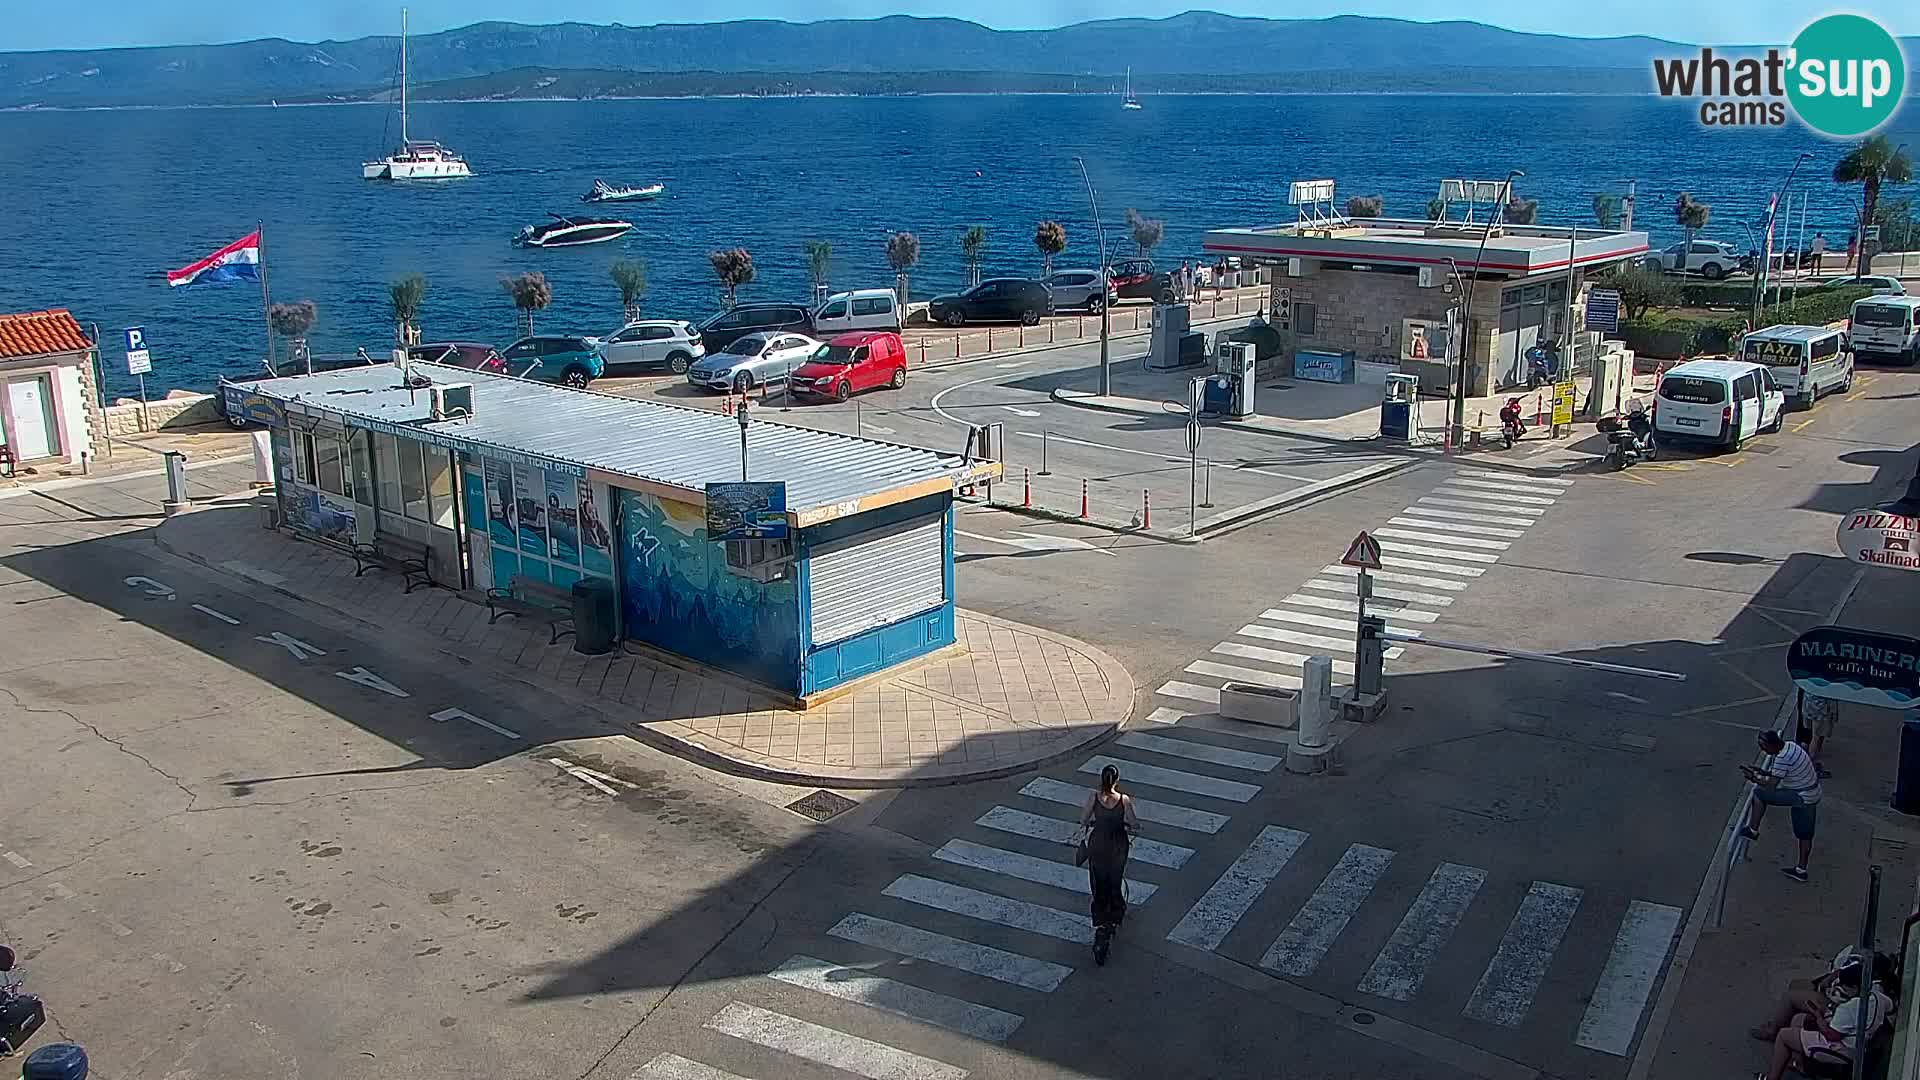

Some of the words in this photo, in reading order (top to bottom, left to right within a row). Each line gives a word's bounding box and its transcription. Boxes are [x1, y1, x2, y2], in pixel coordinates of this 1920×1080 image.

[128, 330, 142, 350] P
[1753, 342, 1794, 357] TAXI
[395, 426, 435, 446] AUTOBUSNA
[436, 436, 467, 451] POSTAJA
[493, 447, 526, 465] STATION
[527, 455, 553, 471] TICKET
[554, 462, 582, 478] OFFICE
[1880, 528, 1917, 540] GRILL
[1828, 660, 1865, 674] caffe
[1869, 665, 1896, 680] bar
